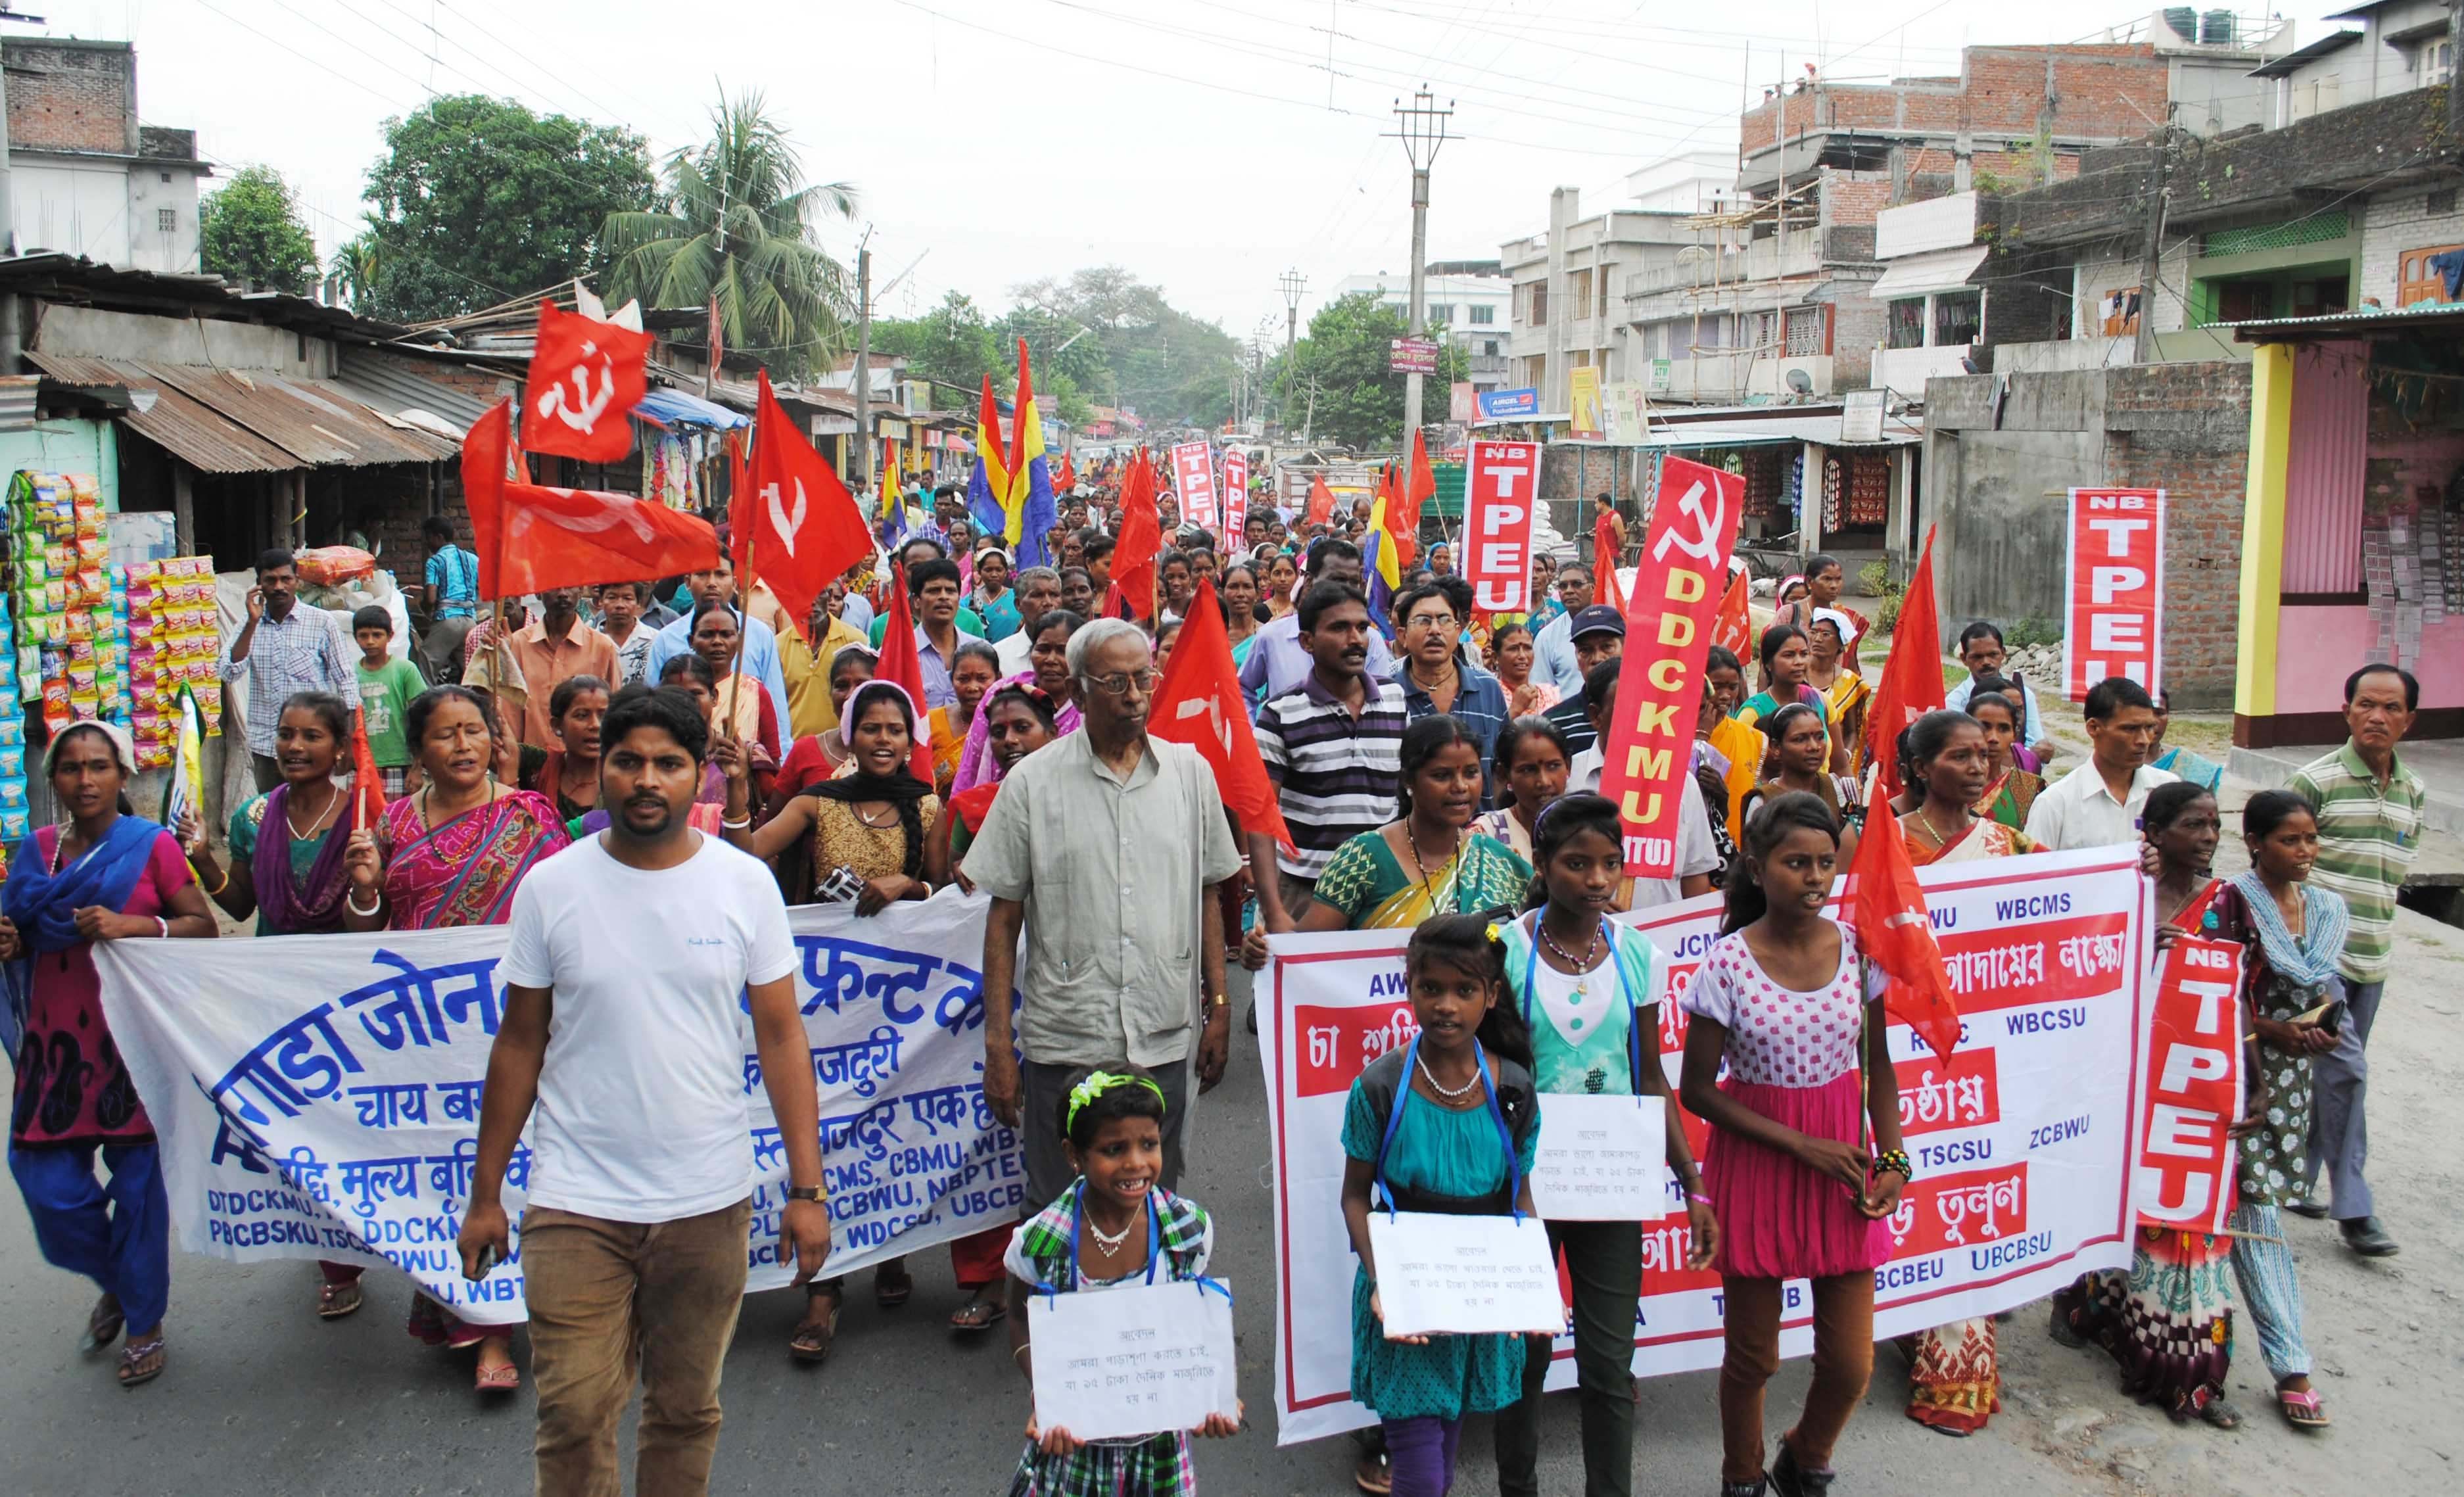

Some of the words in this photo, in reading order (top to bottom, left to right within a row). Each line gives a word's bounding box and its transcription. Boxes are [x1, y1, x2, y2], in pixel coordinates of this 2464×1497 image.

[1654, 366, 1668, 377] ATM
[1492, 396, 1518, 406] AIRCEL
[1181, 445, 1203, 454] NB
[1484, 447, 1527, 460] NB
[1227, 465, 1243, 552] TPEU
[2090, 496, 2145, 510] NB
[1476, 465, 1528, 611] TPEU
[1621, 567, 1705, 824] DDCKMU
[1623, 836, 1672, 866] ITU)
[1996, 892, 2072, 921] WBCMS
[2185, 947, 2230, 969] NB
[2006, 1007, 2087, 1036] WBCSU
[1307, 1025, 1340, 1068] চা
[347, 1083, 429, 1128] चाय
[810, 1026, 904, 1097] जदुरी
[904, 1085, 966, 1136] एक
[2137, 980, 2231, 1222] TPEU
[1919, 1138, 1992, 1168] TSCSU
[2029, 1114, 2091, 1149] ZCBWU
[889, 1141, 970, 1177] CBMU,
[951, 1183, 1028, 1217] UBCB
[1935, 1176, 2022, 1245] তুলুন
[363, 1215, 460, 1245] DDCKM
[1874, 1257, 1944, 1291] BCBEU
[1971, 1230, 2052, 1271] UBCBSU
